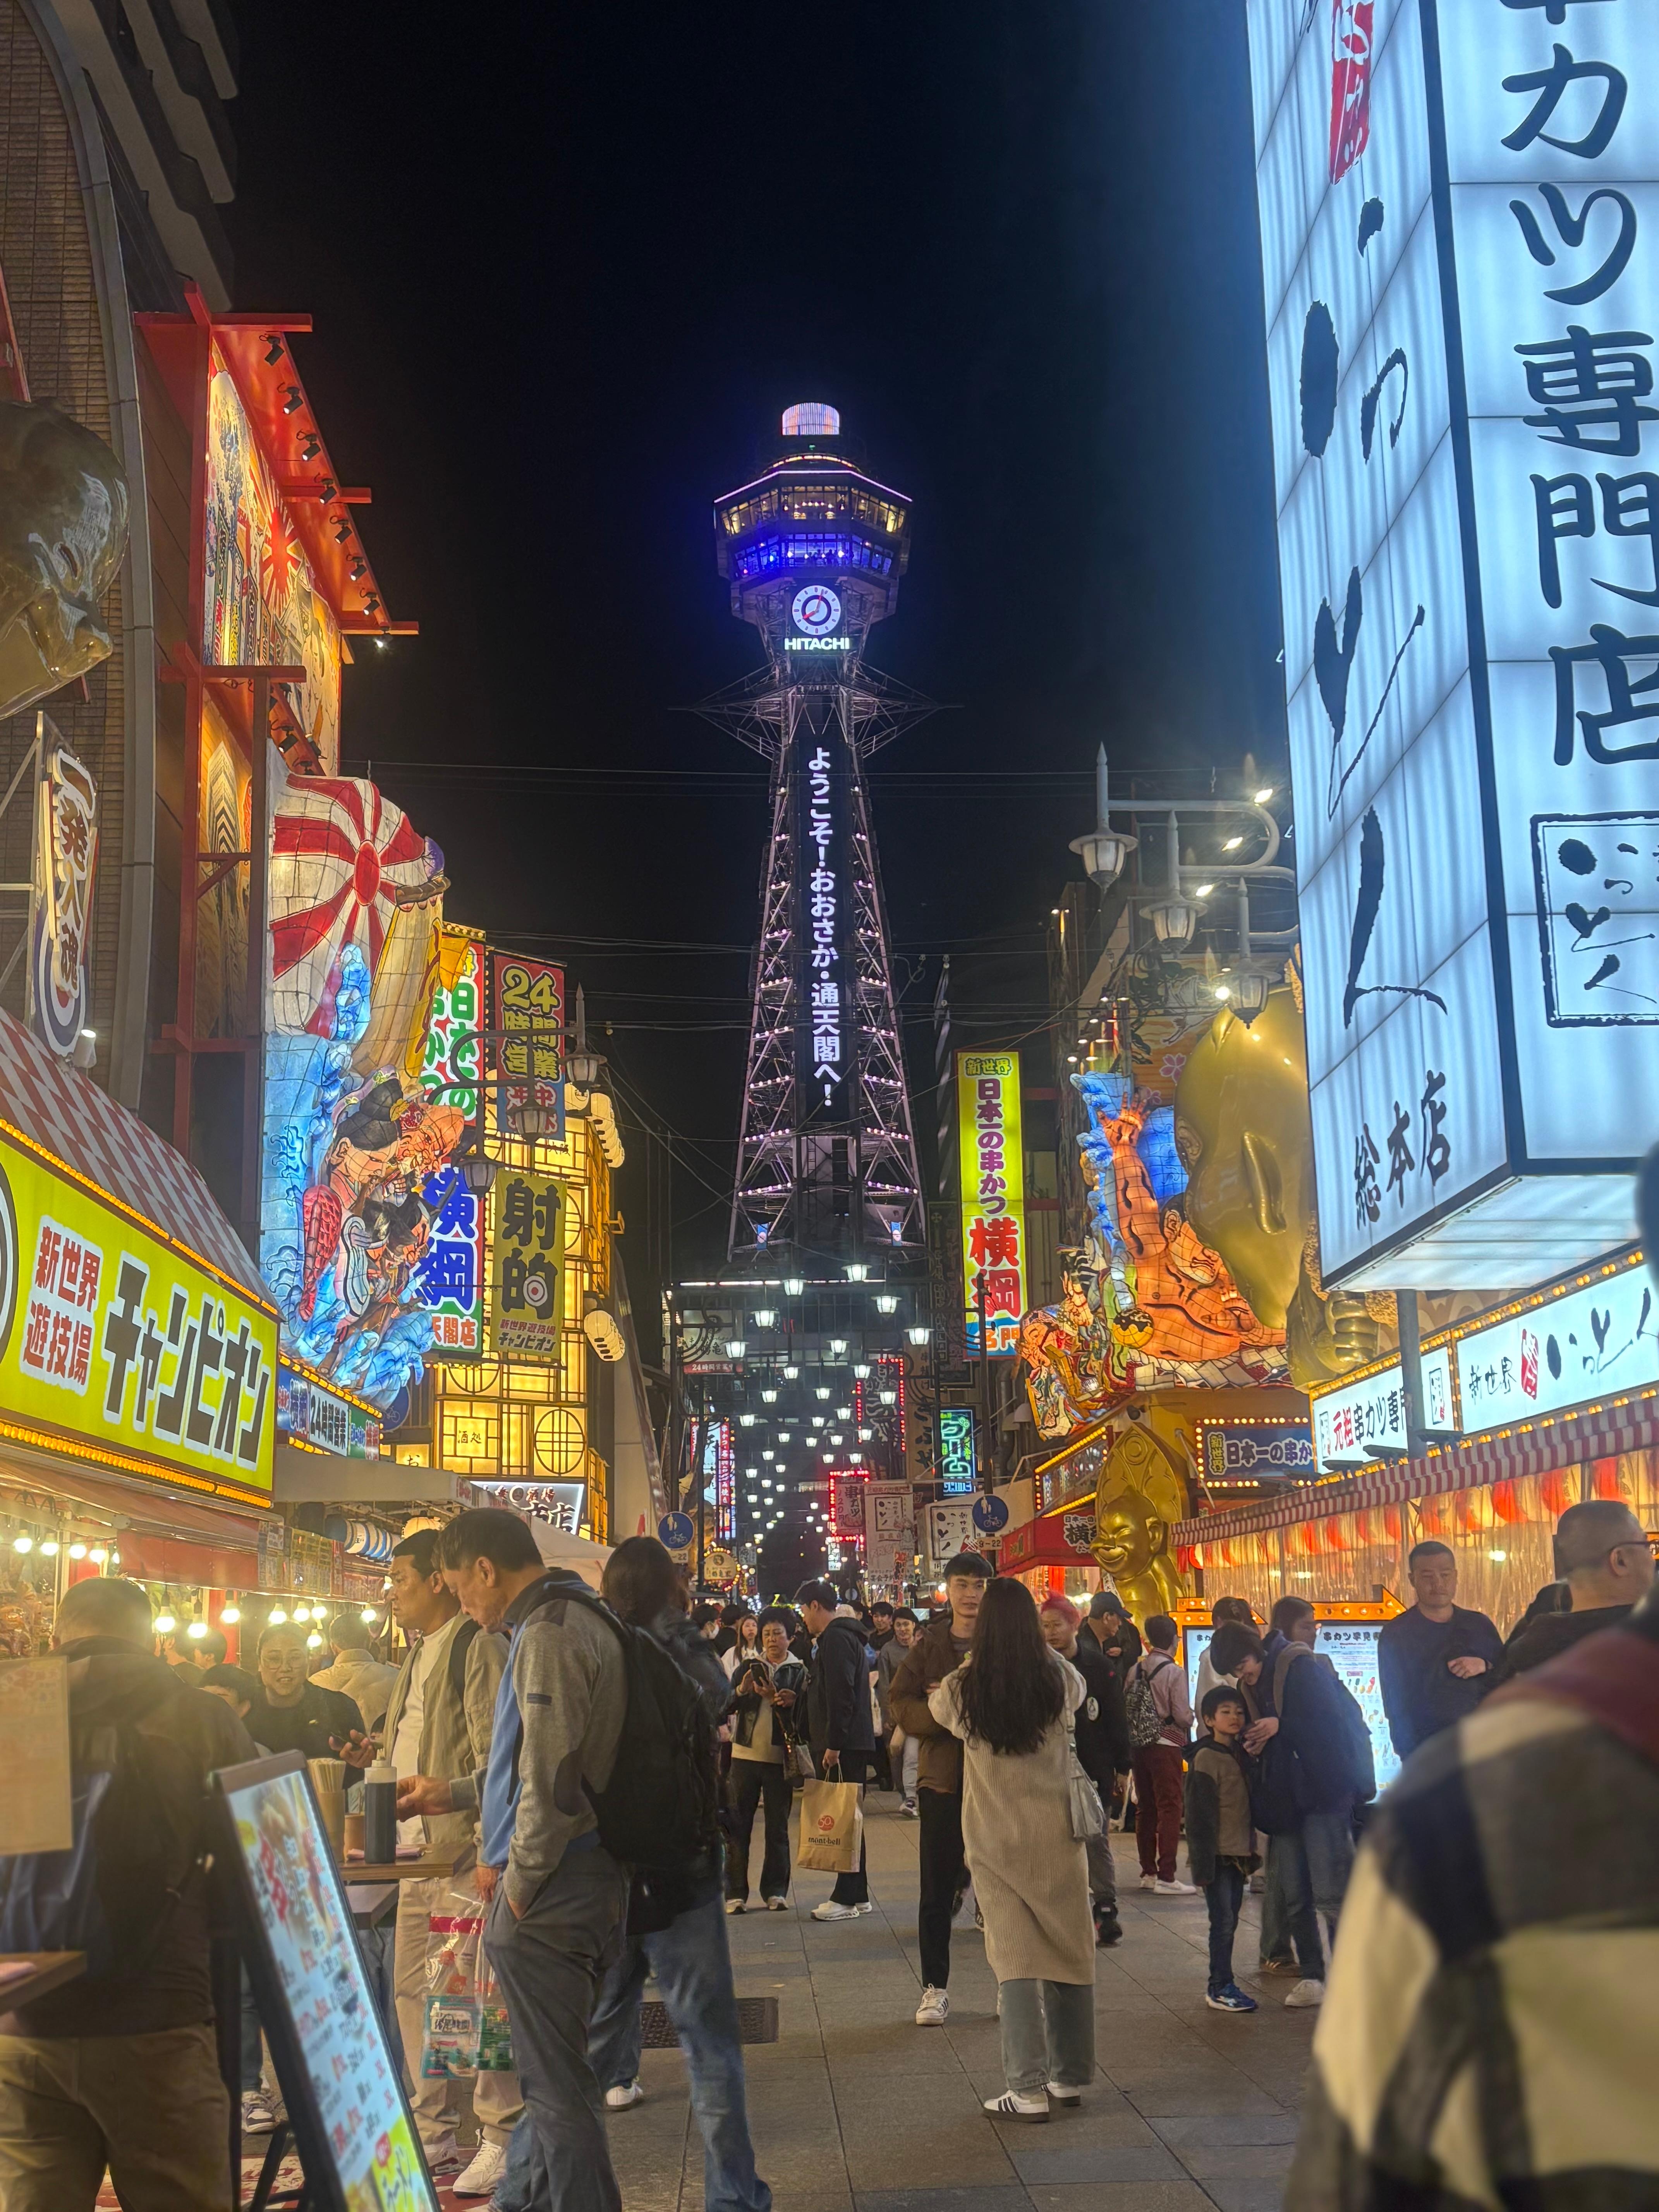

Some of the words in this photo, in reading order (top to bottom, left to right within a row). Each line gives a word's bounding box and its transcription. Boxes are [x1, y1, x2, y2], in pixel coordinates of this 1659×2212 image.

[1499, 0, 1659, 766] カツ専門店
[784, 637, 849, 650] HITACHI
[503, 968, 558, 1013] 24
[966, 1058, 1011, 1076] 新世界
[977, 1079, 1006, 1215] 日本一の串かつ
[35, 1226, 100, 1308] 新世界
[501, 1178, 562, 1320] 射的
[969, 1217, 1022, 1319] 横綱
[24, 1300, 93, 1386] 遊技場
[498, 1332, 556, 1353] チャンピオン
[500, 1319, 556, 1336] 新世界遊技場
[105, 1260, 269, 1463] チャンピオン
[1469, 1357, 1517, 1405] 新世界
[458, 1430, 482, 1444] 酒処
[1209, 1433, 1224, 1474] 新世界
[1226, 1439, 1312, 1465] 日本一の串か
